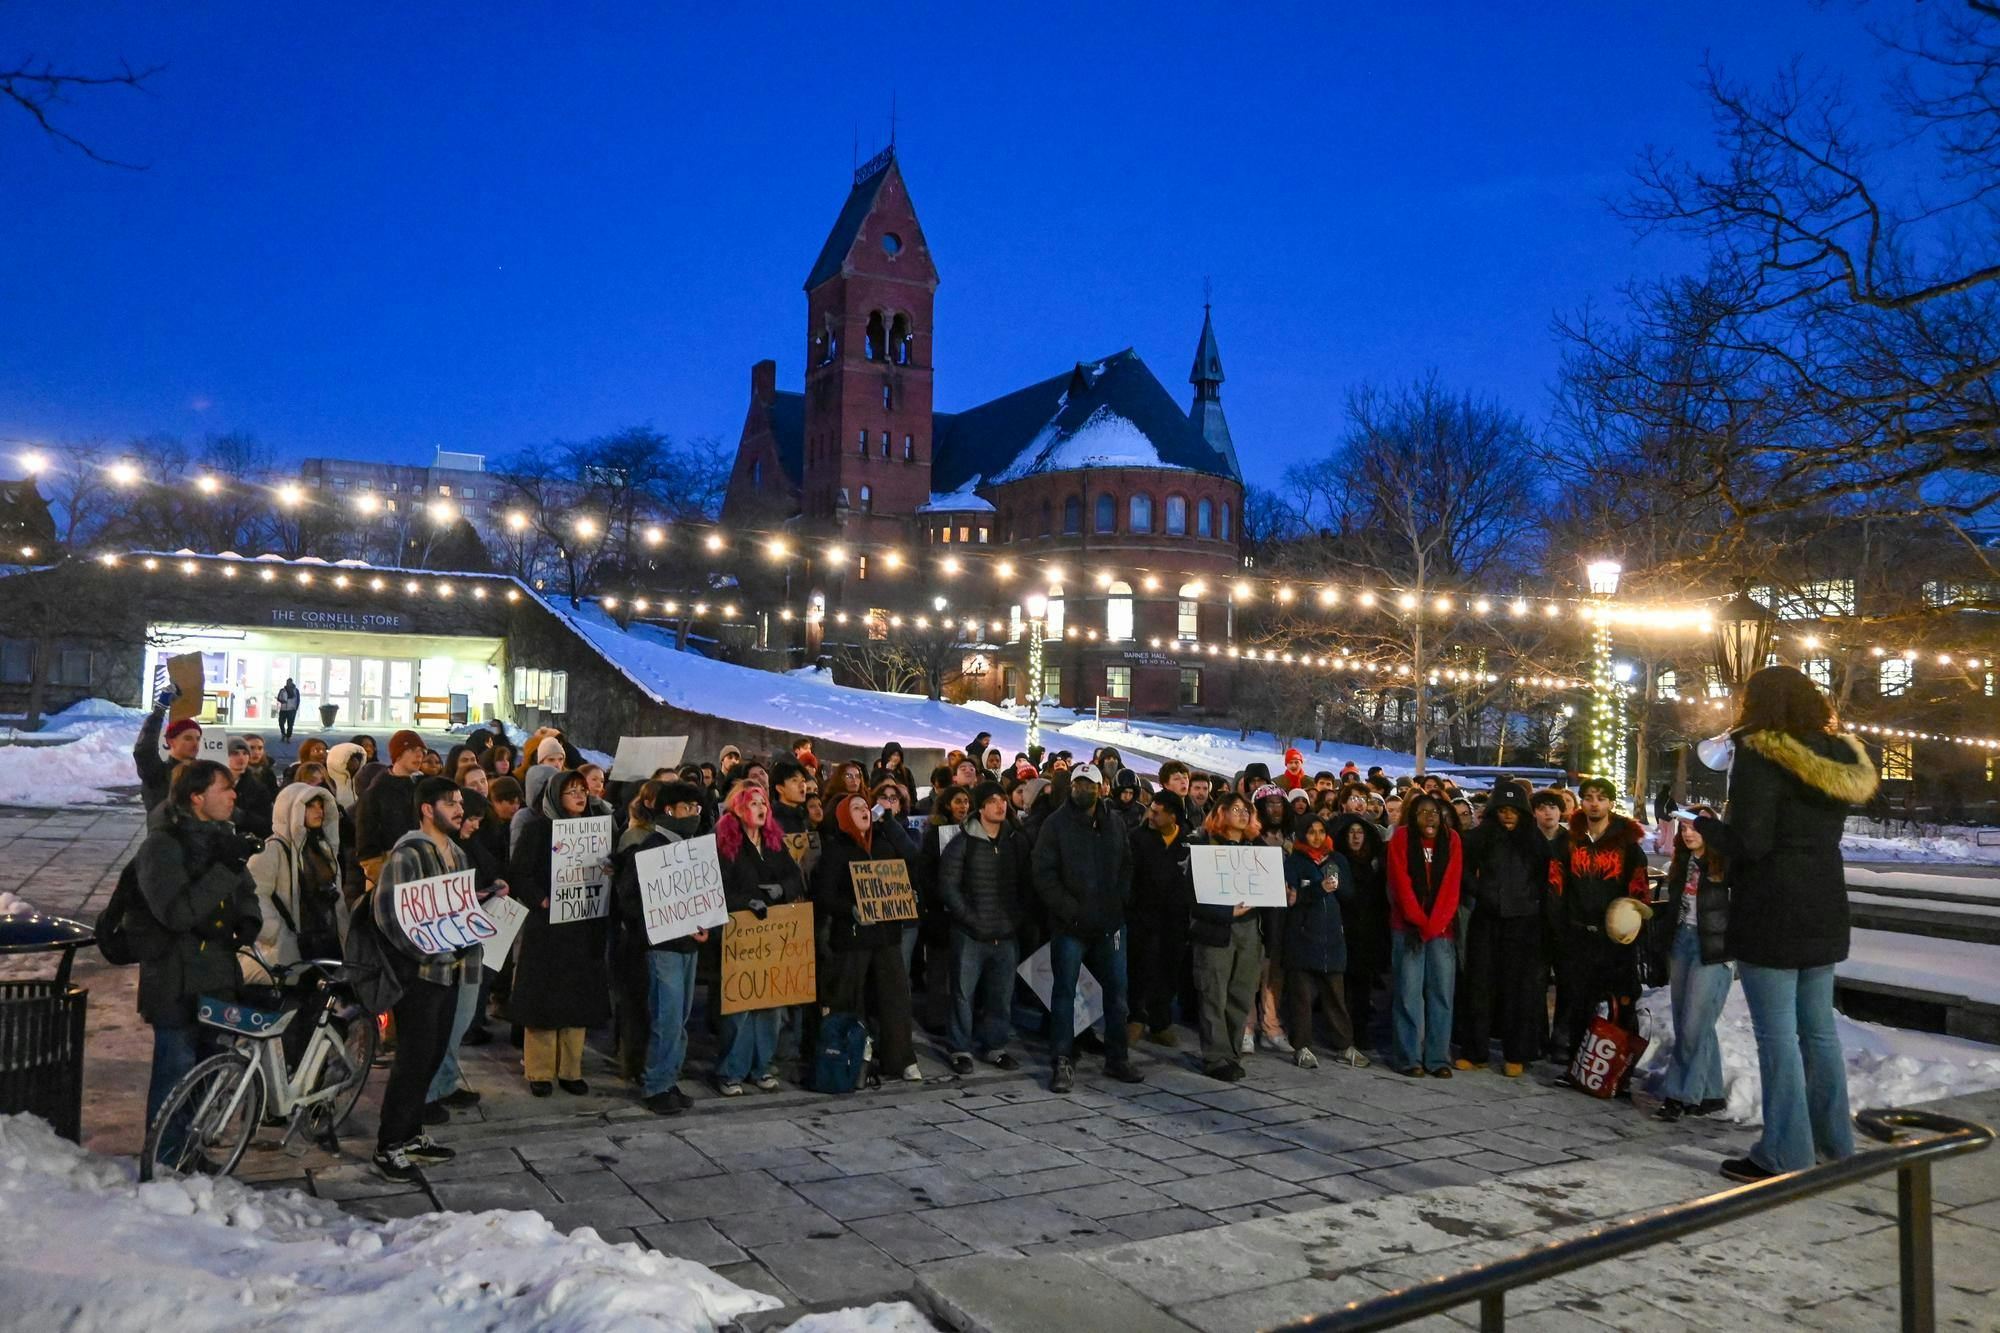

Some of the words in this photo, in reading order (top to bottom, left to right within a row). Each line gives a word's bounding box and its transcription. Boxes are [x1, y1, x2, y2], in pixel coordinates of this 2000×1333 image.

[271, 609, 296, 621] THE
[301, 611, 357, 624] CORNELL
[362, 614, 400, 626] STORE
[340, 623, 366, 631] PLAZA
[1151, 652, 1167, 660] HALL
[555, 823, 575, 835] THE
[579, 821, 608, 834] WHOLE
[560, 835, 609, 856] SYSTEM
[660, 839, 698, 869] ICE
[567, 855, 583, 867] IS
[853, 864, 873, 875] THE
[875, 864, 906, 877] COLD
[1215, 848, 1269, 874] FUCK
[556, 865, 605, 883] GUILTY
[647, 858, 719, 904] MURDERS
[1216, 872, 1264, 896] ICE
[555, 886, 582, 902] SHUT
[585, 884, 603, 899] IT
[856, 878, 886, 899] NEVER
[400, 875, 476, 926] ABOLISH
[561, 899, 601, 920] DOWN
[647, 886, 724, 930] INNOCENTS
[862, 901, 880, 921] ME
[420, 914, 480, 952] ICE
[725, 915, 798, 939] Democracy
[725, 936, 771, 963] Needs
[724, 961, 816, 1002] COURAGE
